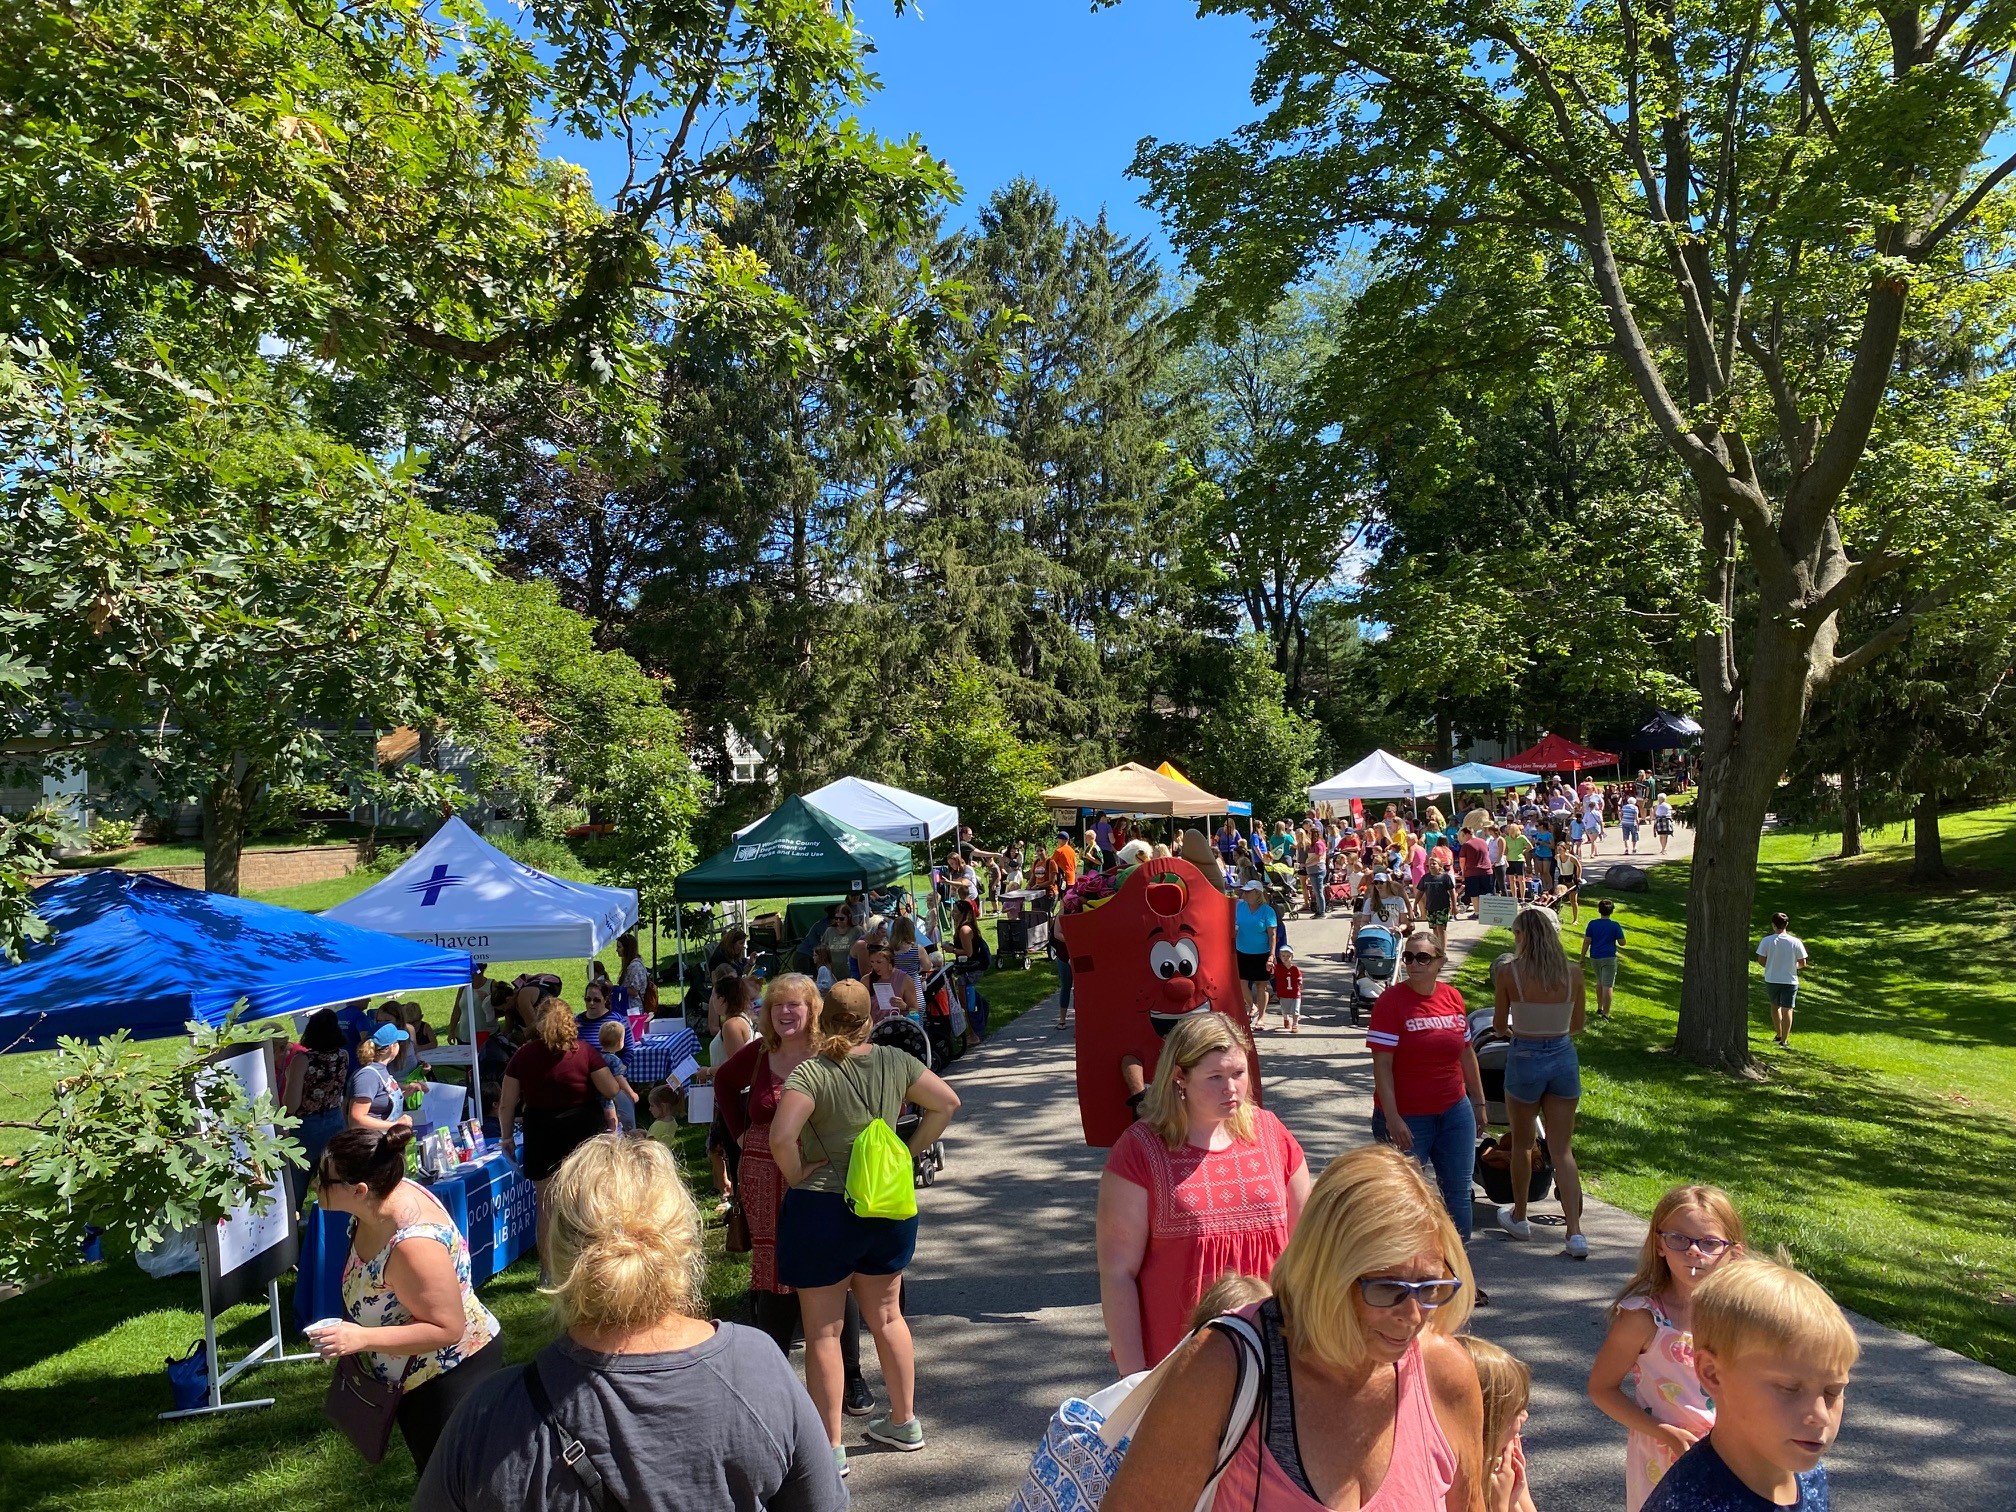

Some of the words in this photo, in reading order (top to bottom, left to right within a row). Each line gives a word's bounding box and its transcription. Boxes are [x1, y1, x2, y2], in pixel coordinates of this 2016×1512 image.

[760, 844, 797, 853] Department
[795, 839, 821, 847] County
[1285, 976, 1293, 990] 1
[1405, 1014, 1466, 1032] SENDIK'S
[503, 1190, 537, 1224] PUBLIC
